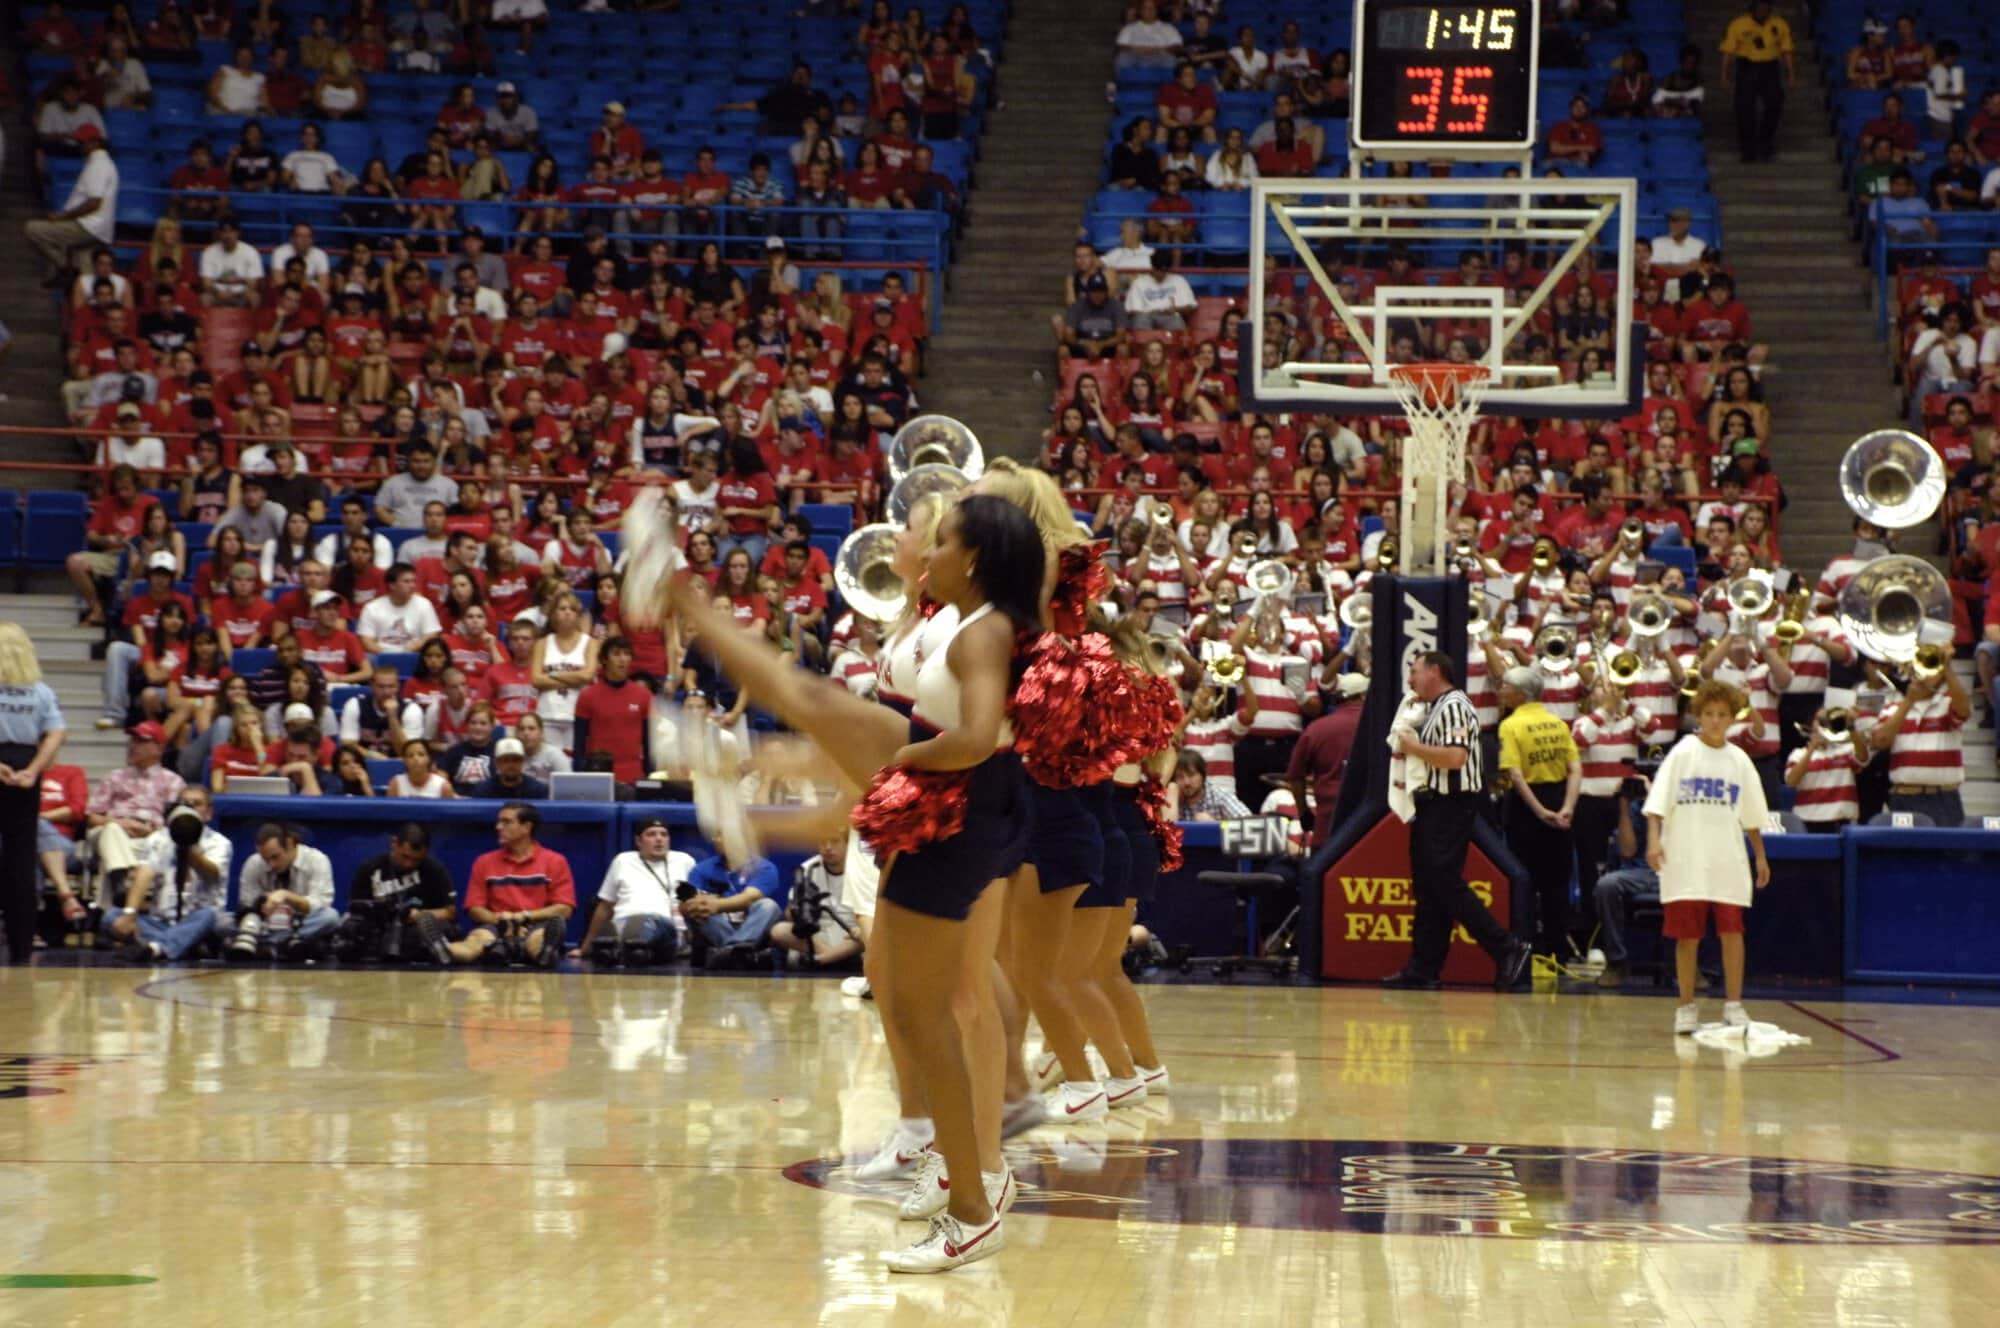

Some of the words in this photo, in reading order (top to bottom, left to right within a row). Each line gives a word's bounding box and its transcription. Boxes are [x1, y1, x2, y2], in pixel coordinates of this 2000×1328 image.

[1425, 9, 1516, 49] 1:45
[1397, 66, 1493, 132] 35
[1222, 817, 1288, 854] FSN
